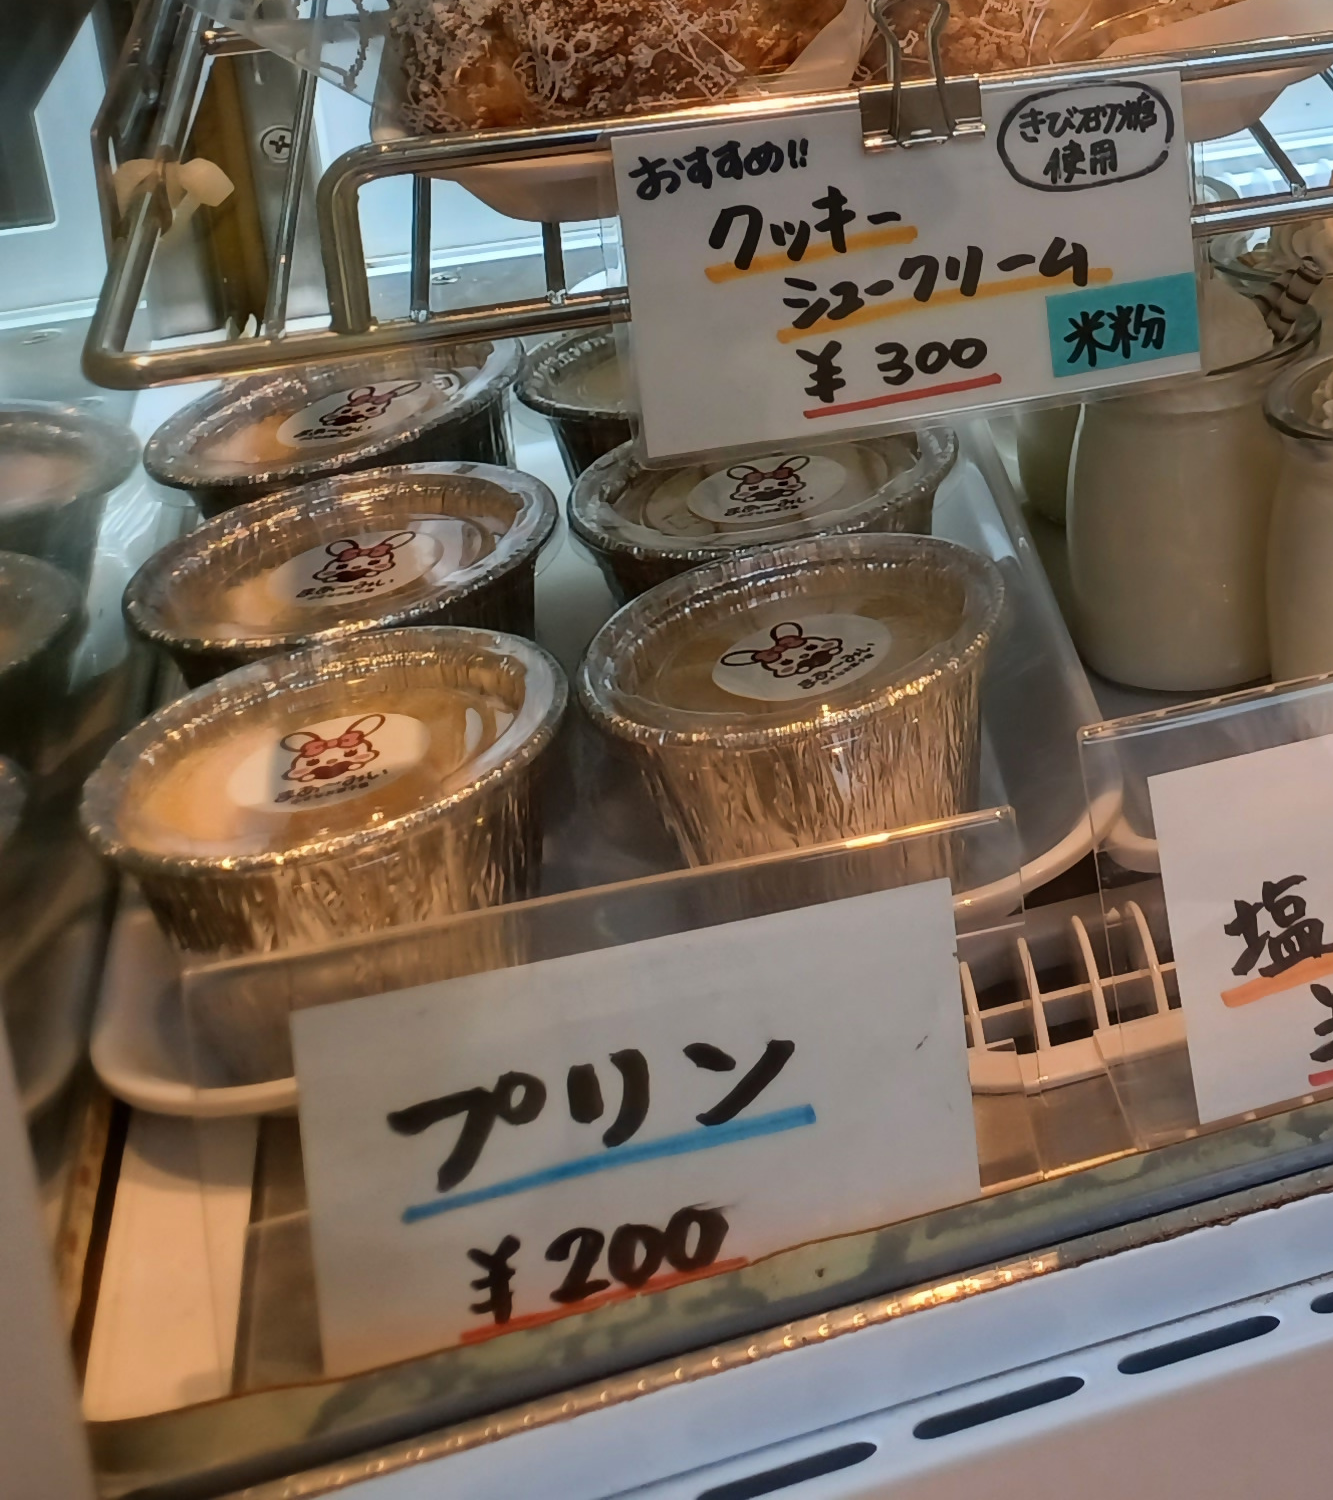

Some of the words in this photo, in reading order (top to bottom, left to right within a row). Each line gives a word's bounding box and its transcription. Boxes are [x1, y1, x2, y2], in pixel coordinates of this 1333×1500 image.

[1043, 140, 1120, 184] 使用
[708, 185, 903, 271] クッキー
[782, 235, 1090, 331] シュークリーム
[795, 336, 988, 403] ¥300
[1064, 303, 1167, 367] 米粉
[387, 1039, 795, 1193] プリン
[467, 1205, 732, 1325] ¥200
